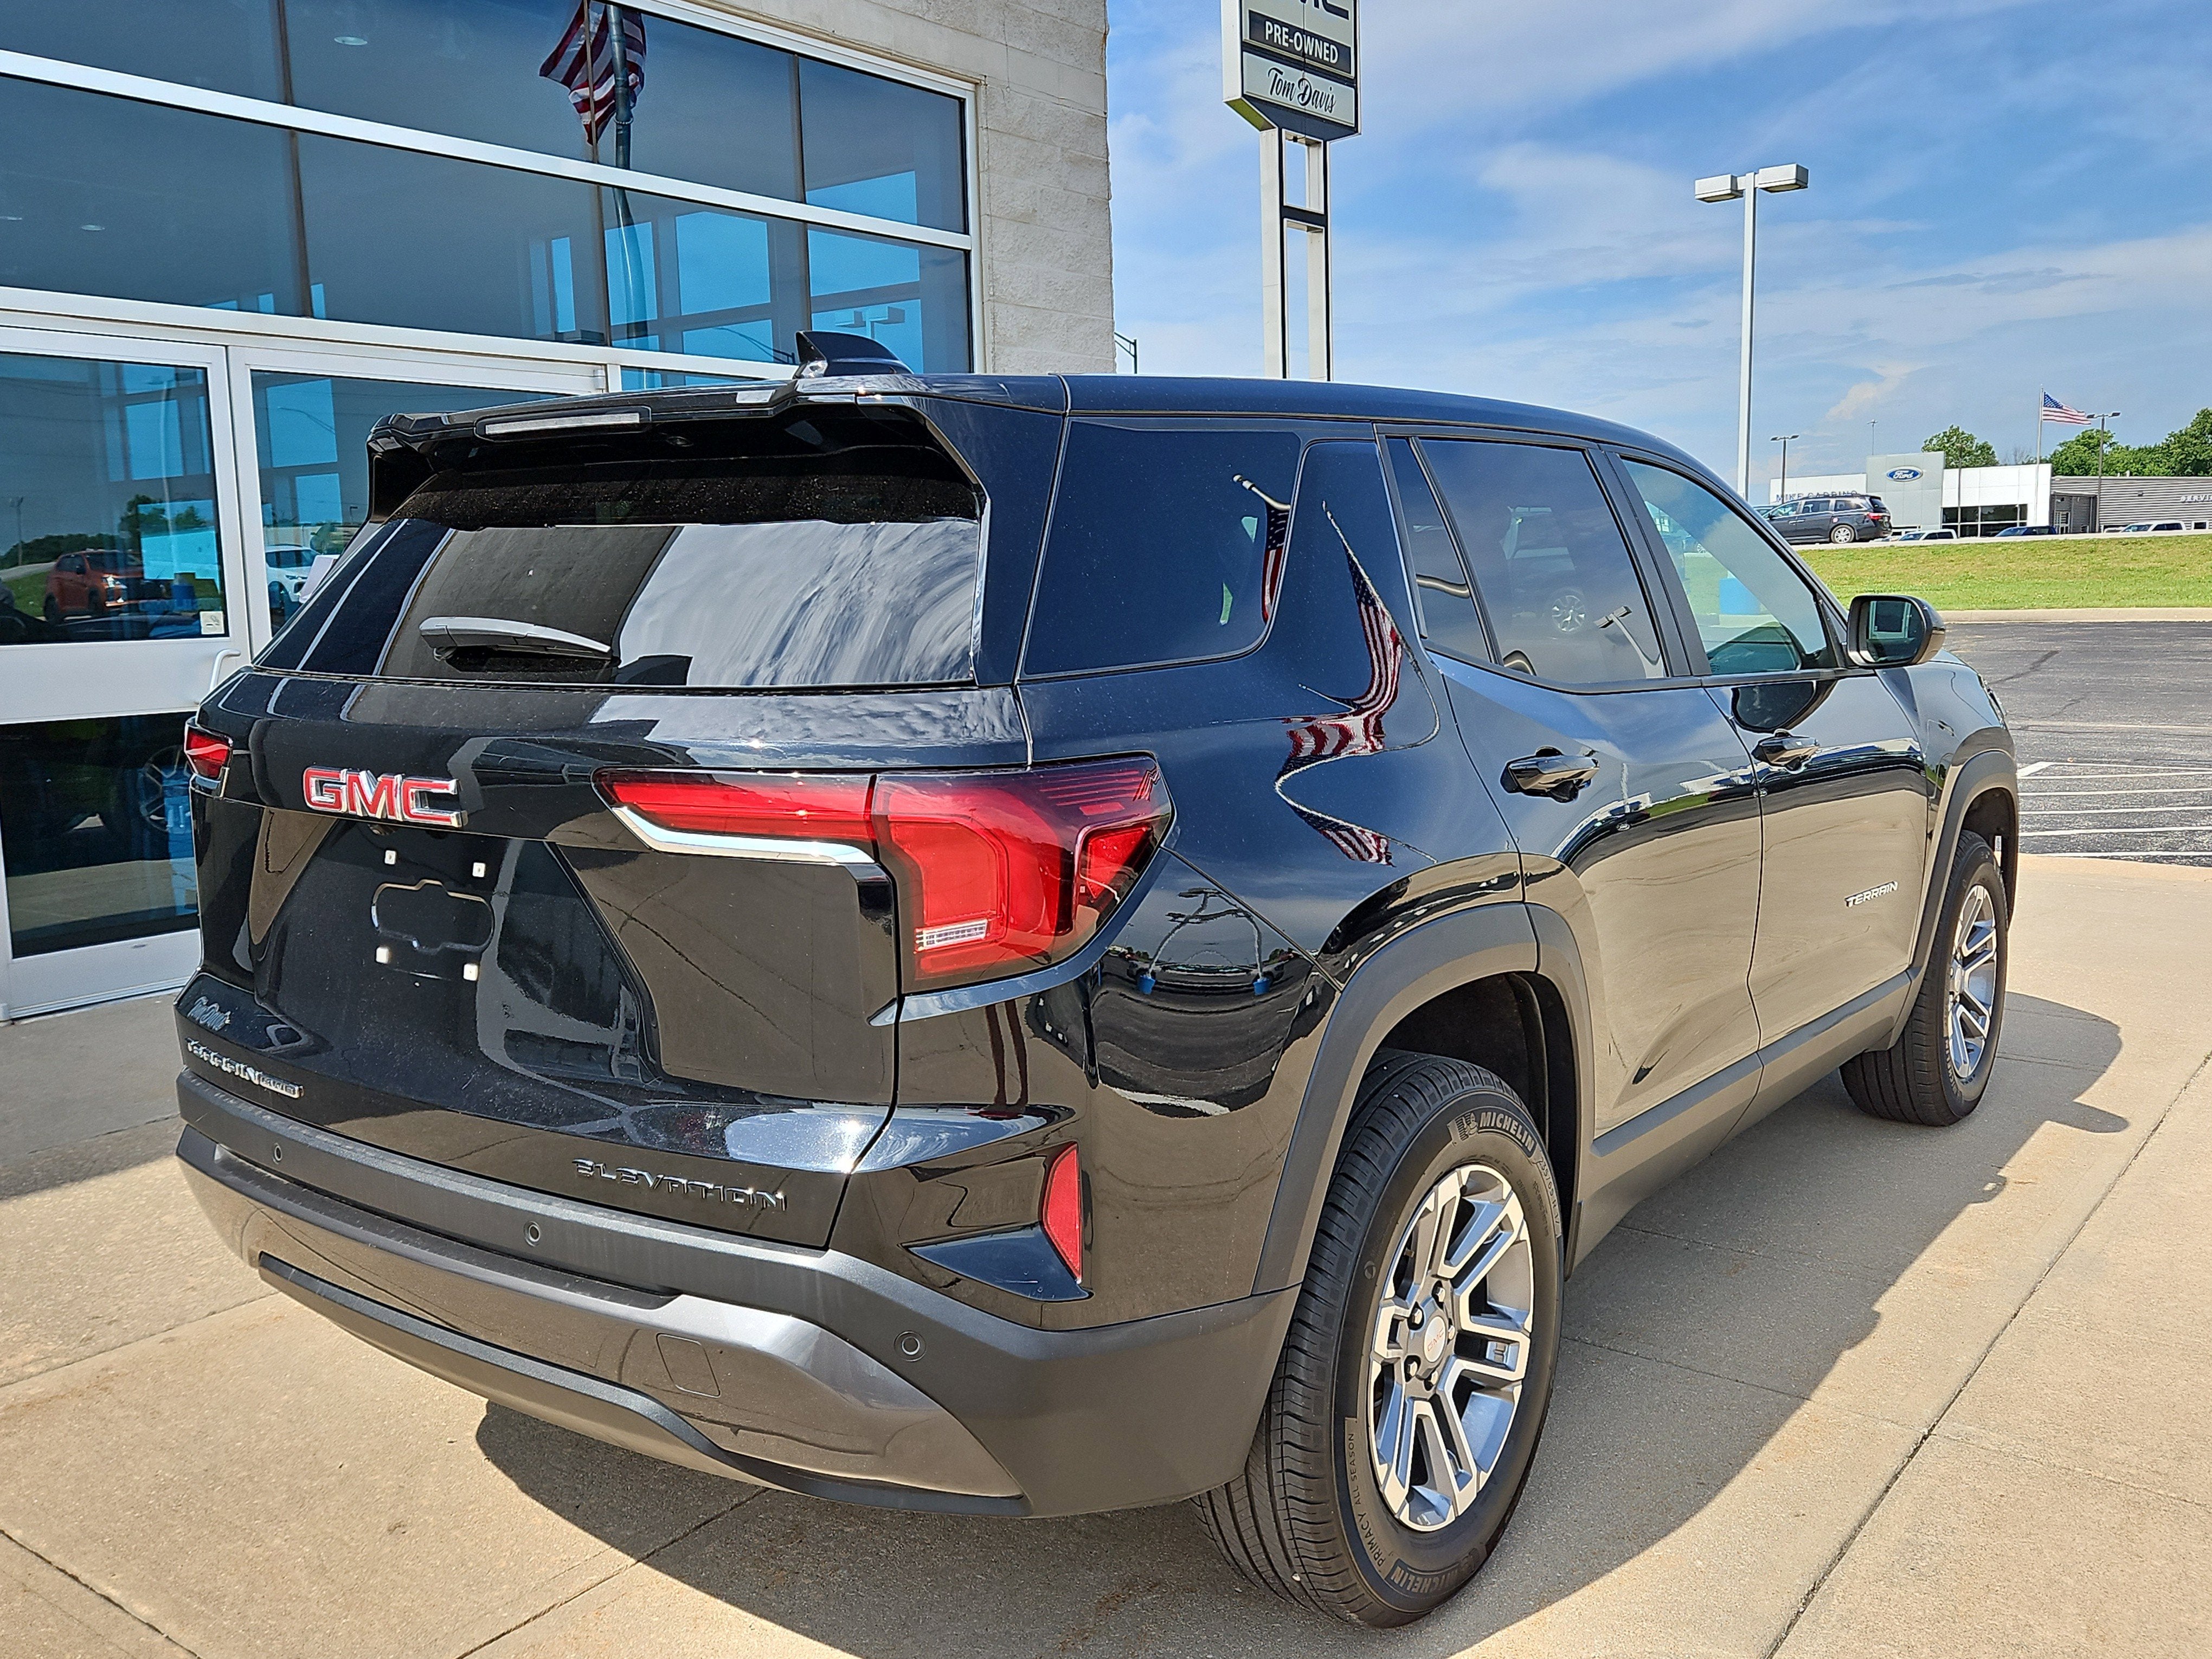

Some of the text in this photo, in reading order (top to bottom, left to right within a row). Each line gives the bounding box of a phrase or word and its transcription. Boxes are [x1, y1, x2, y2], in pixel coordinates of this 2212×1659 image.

[1265, 21, 1339, 64] PRE-OWNED
[1268, 67, 1336, 113] Tom Davis
[303, 766, 462, 827] GMC
[1844, 880, 1898, 908] TERRAIN
[1480, 1112, 1535, 1152] MICHELIN
[572, 1158, 788, 1211] ELEVATION
[1348, 1433, 1386, 1567] PRIMACY ALL SEASON
